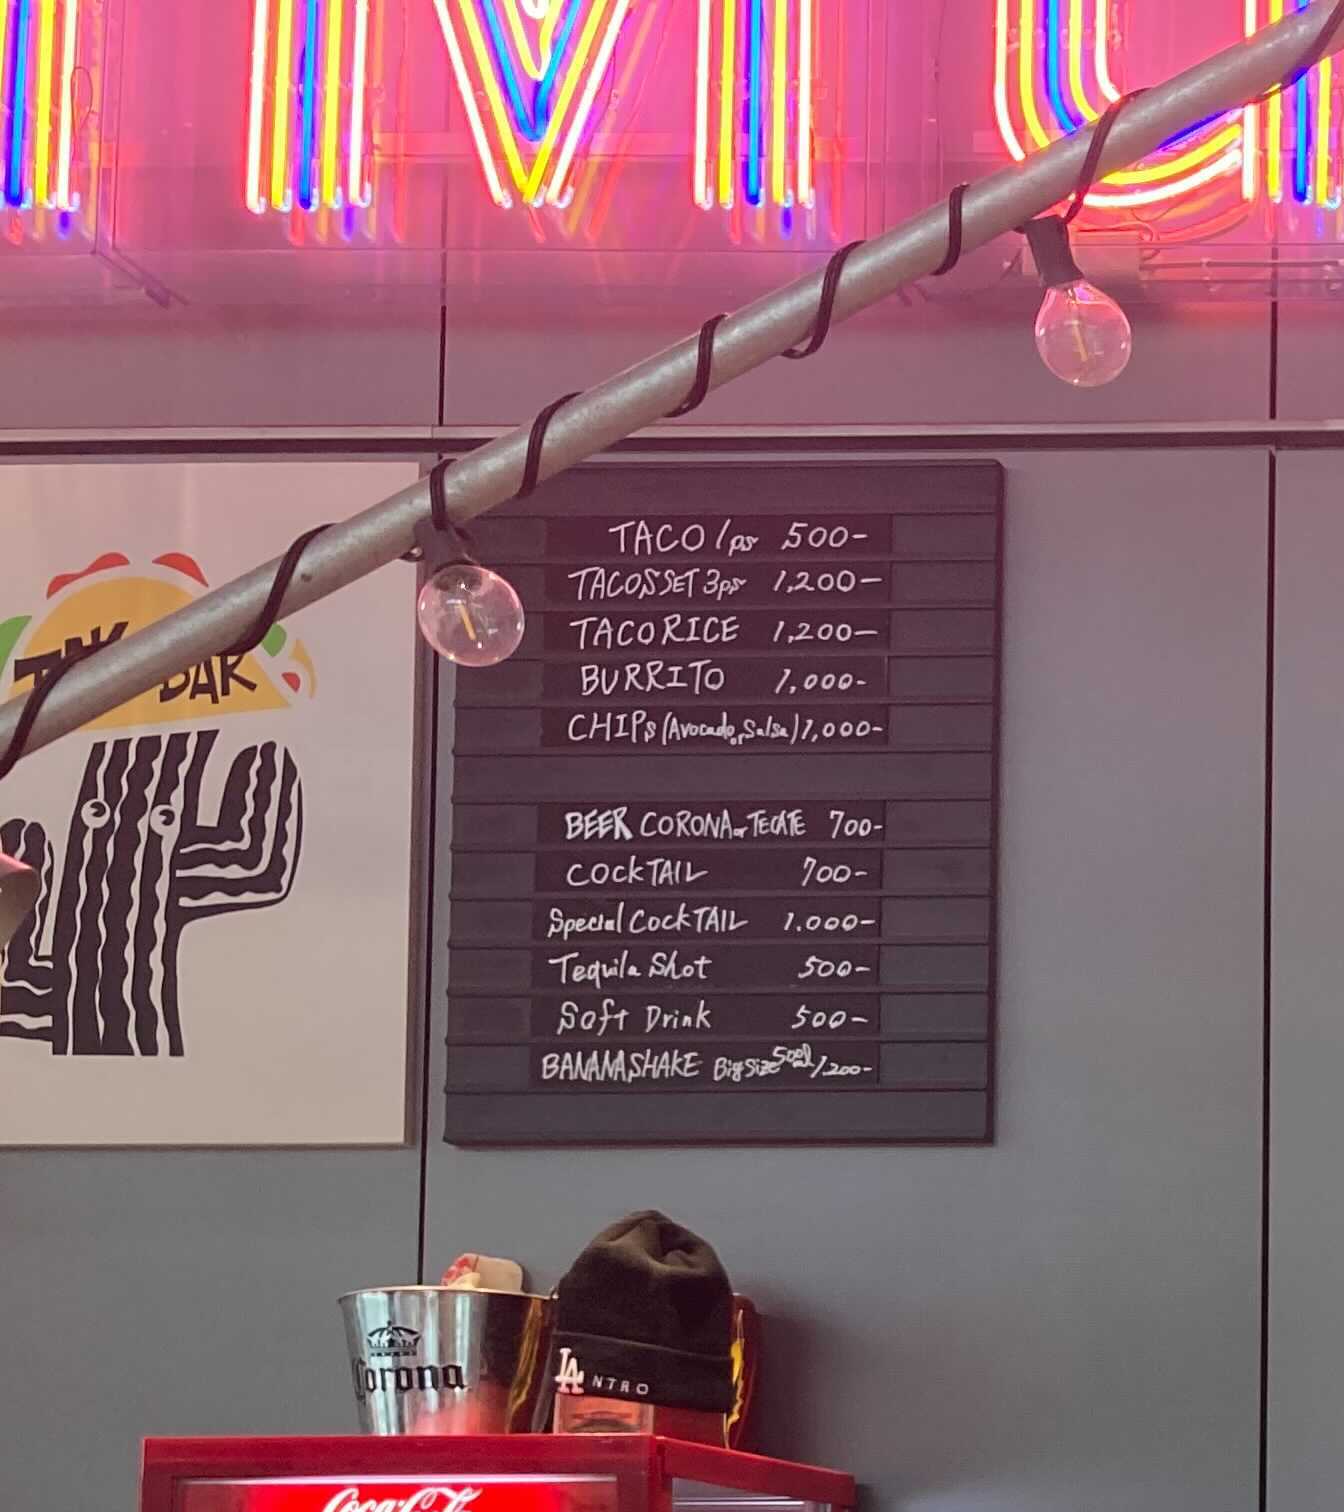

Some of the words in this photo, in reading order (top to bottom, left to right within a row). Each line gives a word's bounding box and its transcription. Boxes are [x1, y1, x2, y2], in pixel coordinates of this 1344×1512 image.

[609, 520, 705, 555] TACO
[580, 660, 724, 695] BURRITO
[565, 807, 633, 840] BEER
[640, 811, 734, 838] CORONA
[548, 902, 623, 939] Special
[548, 950, 641, 988] Tequila
[649, 954, 712, 979] Shot
[557, 999, 629, 1036] Soft
[646, 1001, 711, 1029] Drink
